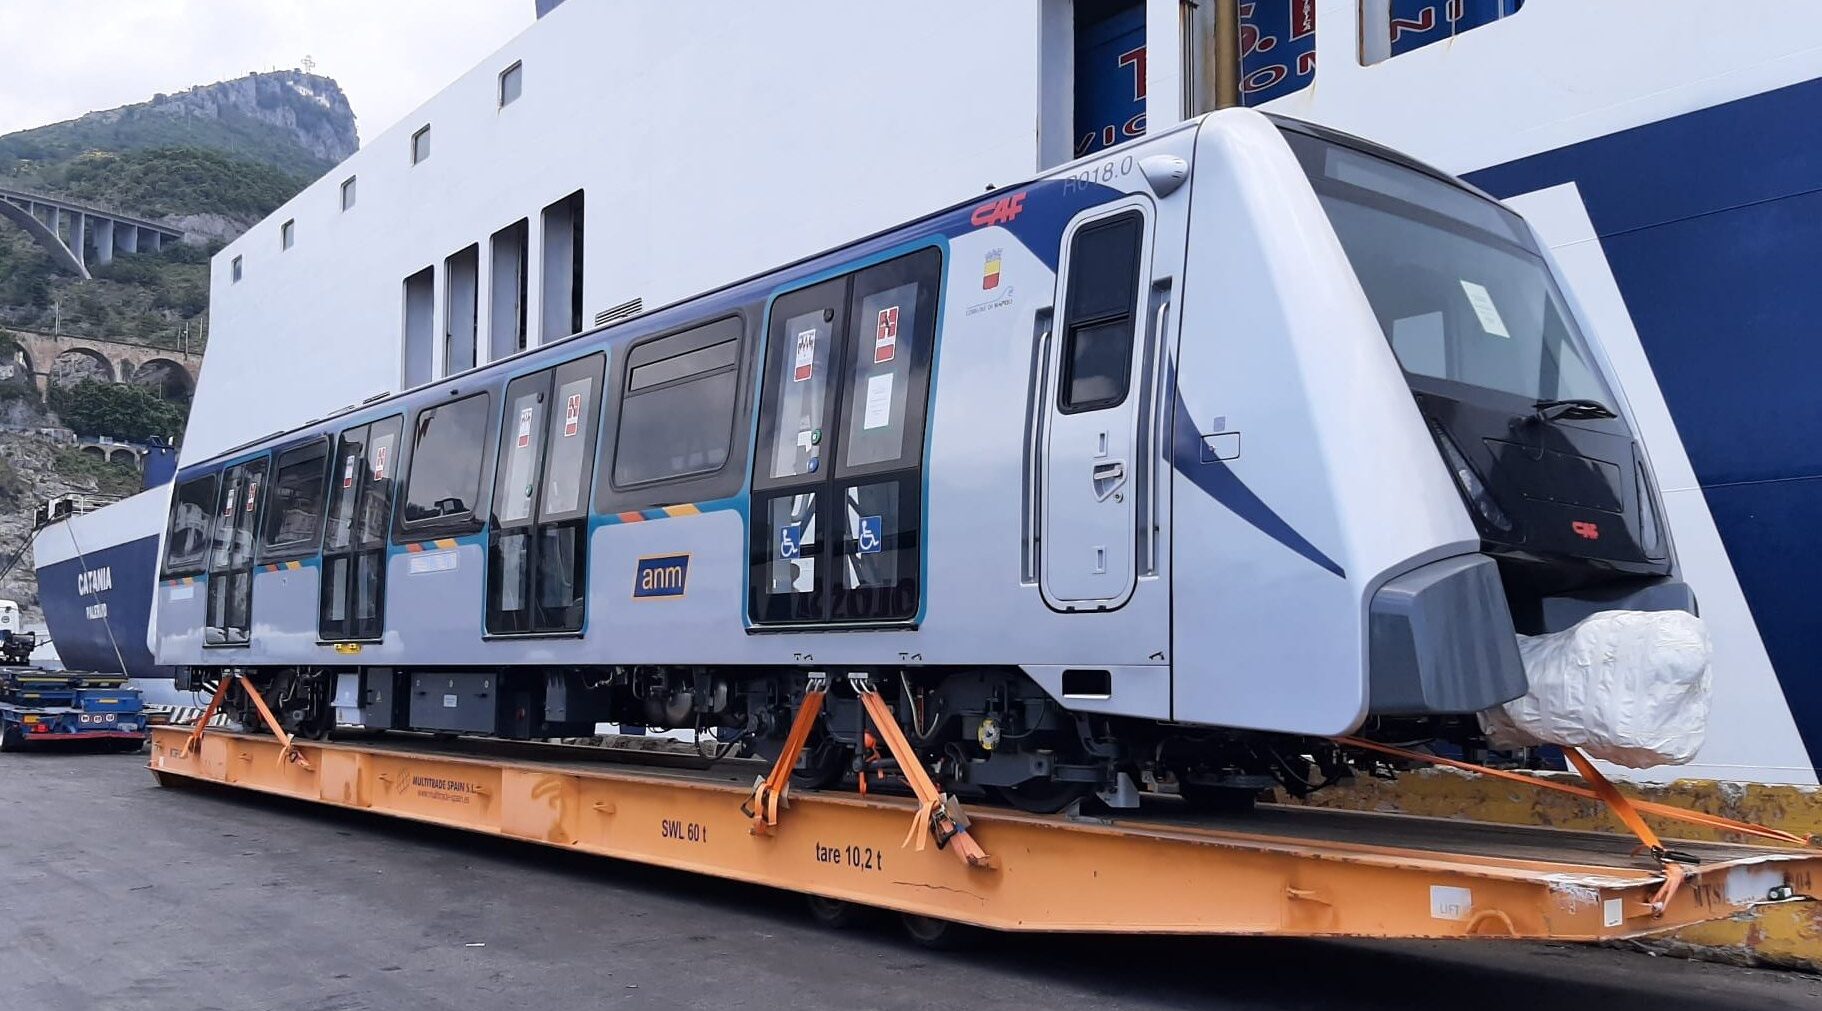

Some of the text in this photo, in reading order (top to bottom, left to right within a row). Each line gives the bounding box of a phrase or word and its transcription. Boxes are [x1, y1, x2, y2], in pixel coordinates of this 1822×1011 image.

[971, 192, 1027, 226] CAF
[78, 566, 112, 596] CATANIA
[642, 566, 681, 590] anm
[412, 776, 446, 790] MULTITRADE
[447, 780, 465, 792] SPAIN
[661, 819, 707, 843] SWL 60 t
[816, 841, 882, 871] tare 10,2 t
